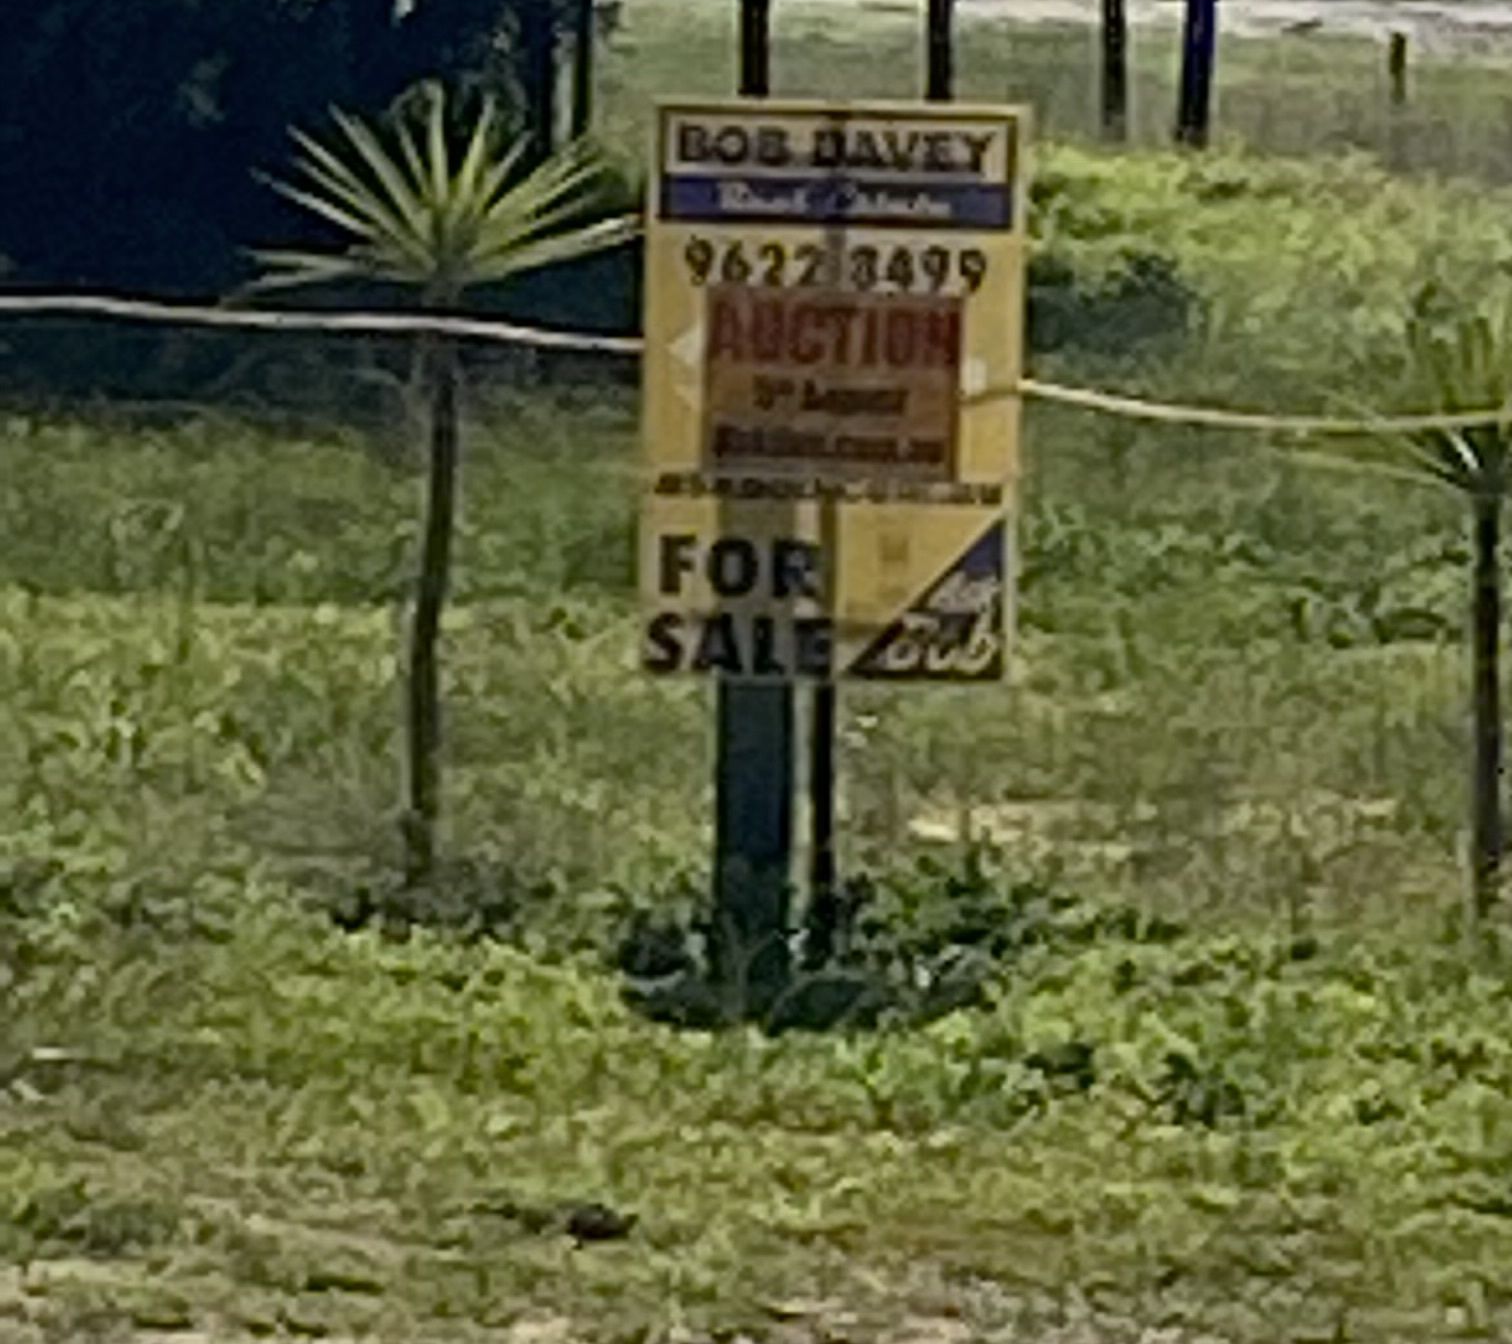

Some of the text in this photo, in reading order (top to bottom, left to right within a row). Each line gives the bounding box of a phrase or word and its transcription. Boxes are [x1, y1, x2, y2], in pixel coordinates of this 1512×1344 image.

[678, 125, 996, 173] BOB DAVEY
[684, 237, 824, 287] 9622
[709, 297, 963, 368] AUCTION
[659, 533, 823, 598] FOR
[642, 610, 834, 676] SALE
